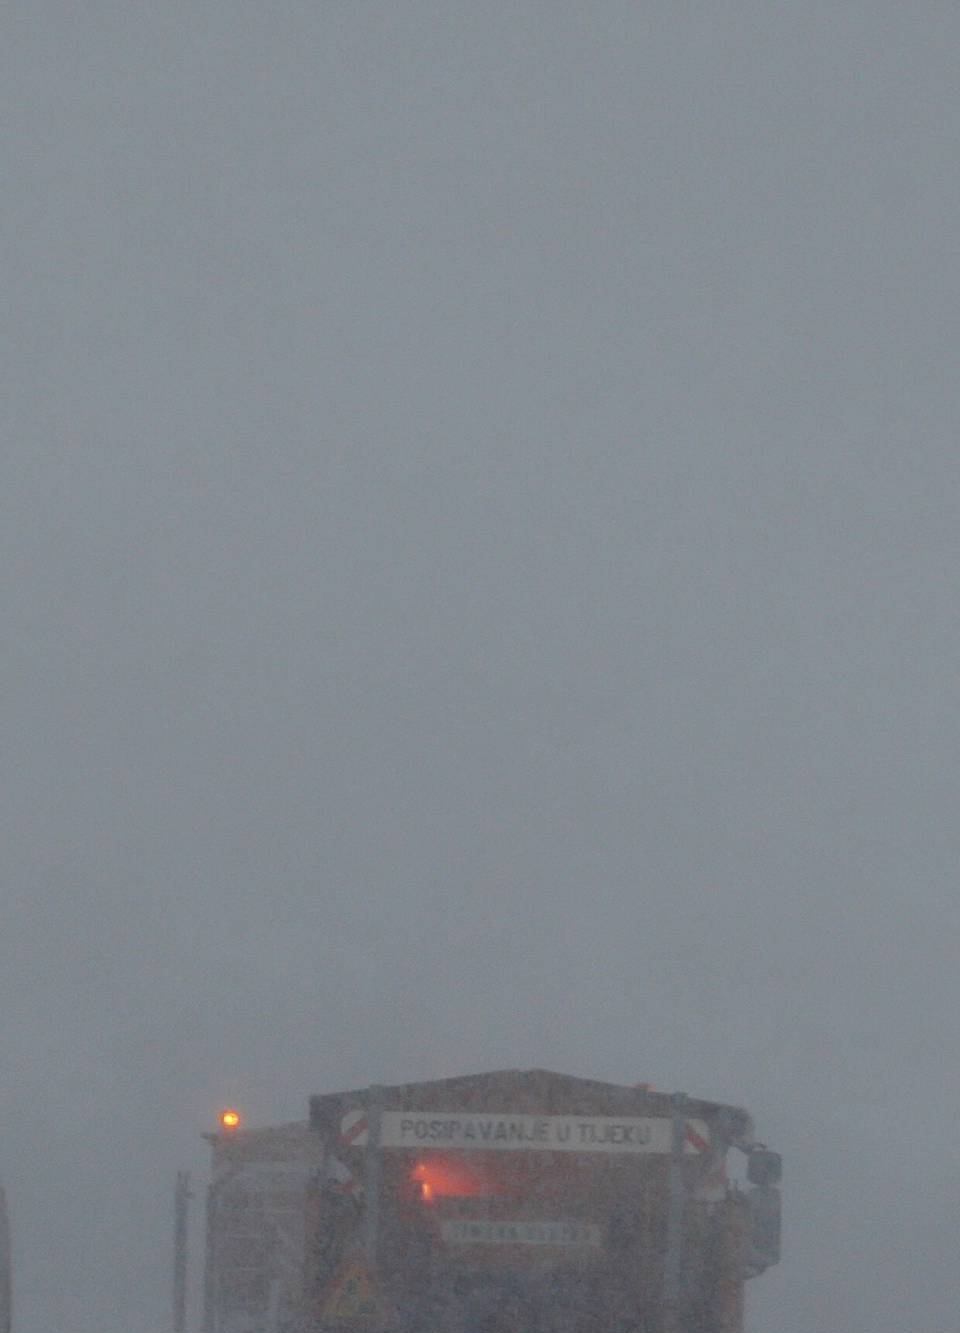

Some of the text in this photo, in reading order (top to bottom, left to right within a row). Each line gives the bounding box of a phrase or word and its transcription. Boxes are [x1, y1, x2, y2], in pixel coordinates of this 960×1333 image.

[400, 1119, 651, 1145] POSIPAVANJE U TIJEKU
